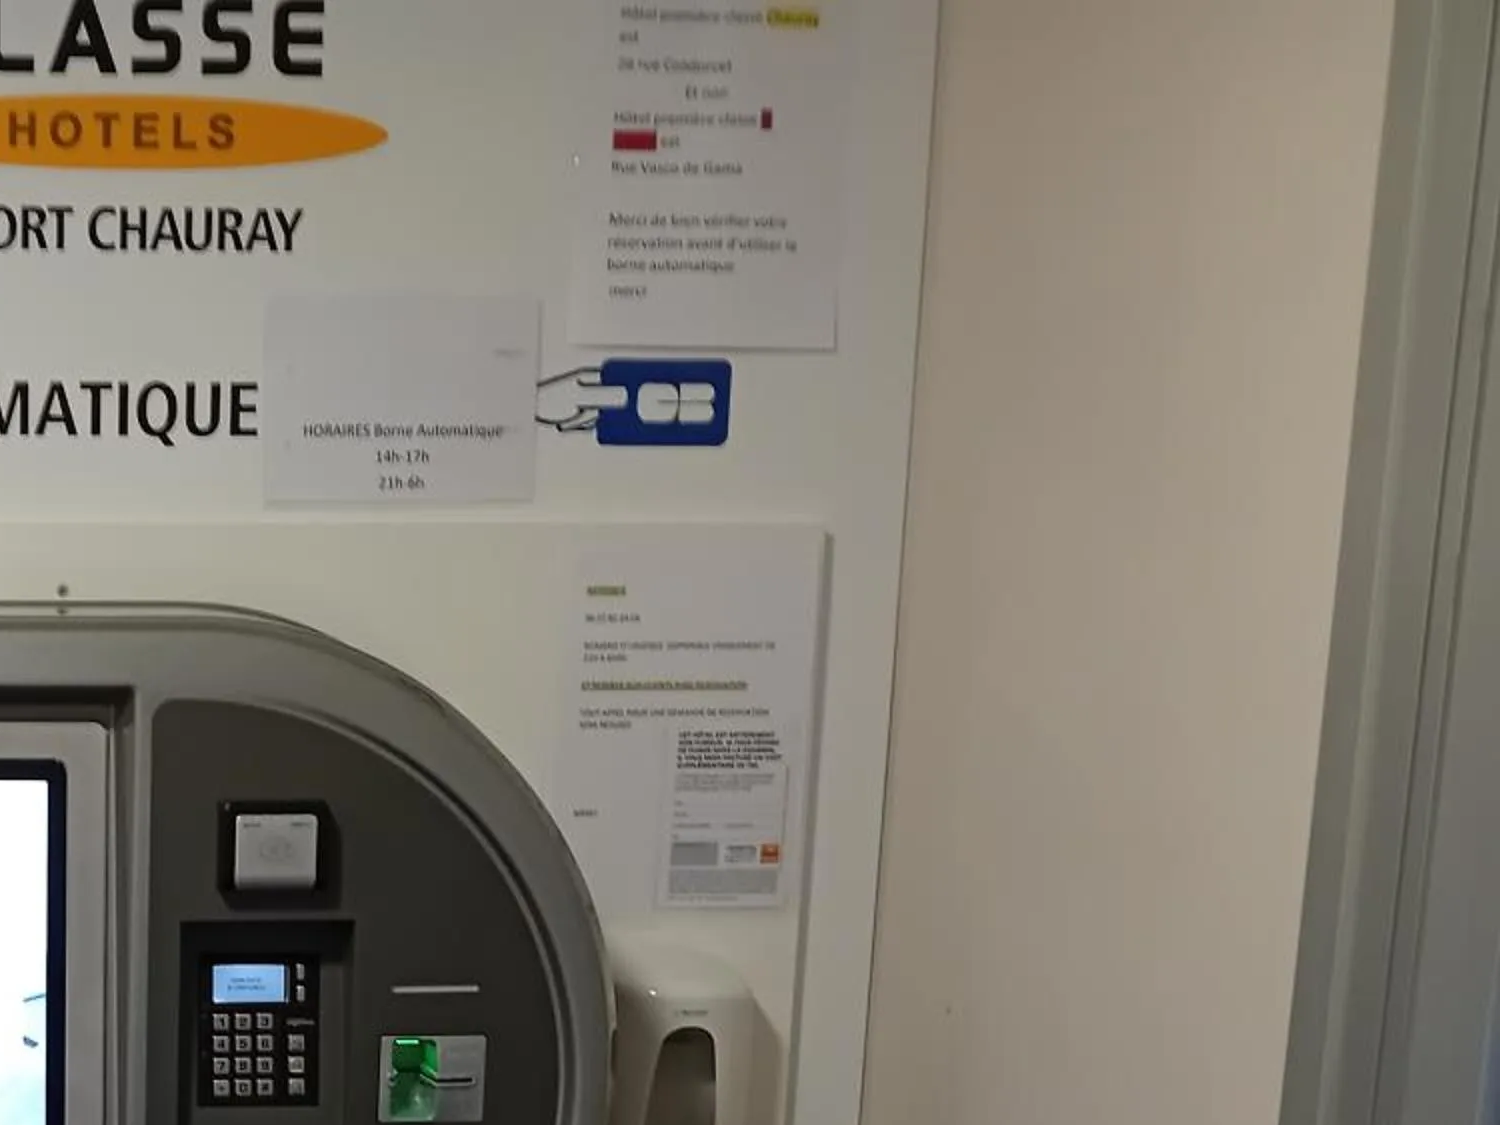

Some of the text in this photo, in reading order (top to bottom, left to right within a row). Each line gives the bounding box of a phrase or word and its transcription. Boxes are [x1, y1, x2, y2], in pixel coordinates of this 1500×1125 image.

[7, 110, 238, 151] HOTELS
[88, 205, 304, 253] CHAURAY
[302, 423, 504, 440] HORAIRES Borne Automatique
[375, 449, 430, 465] 14h-17h
[378, 475, 425, 491] 21h-6h
